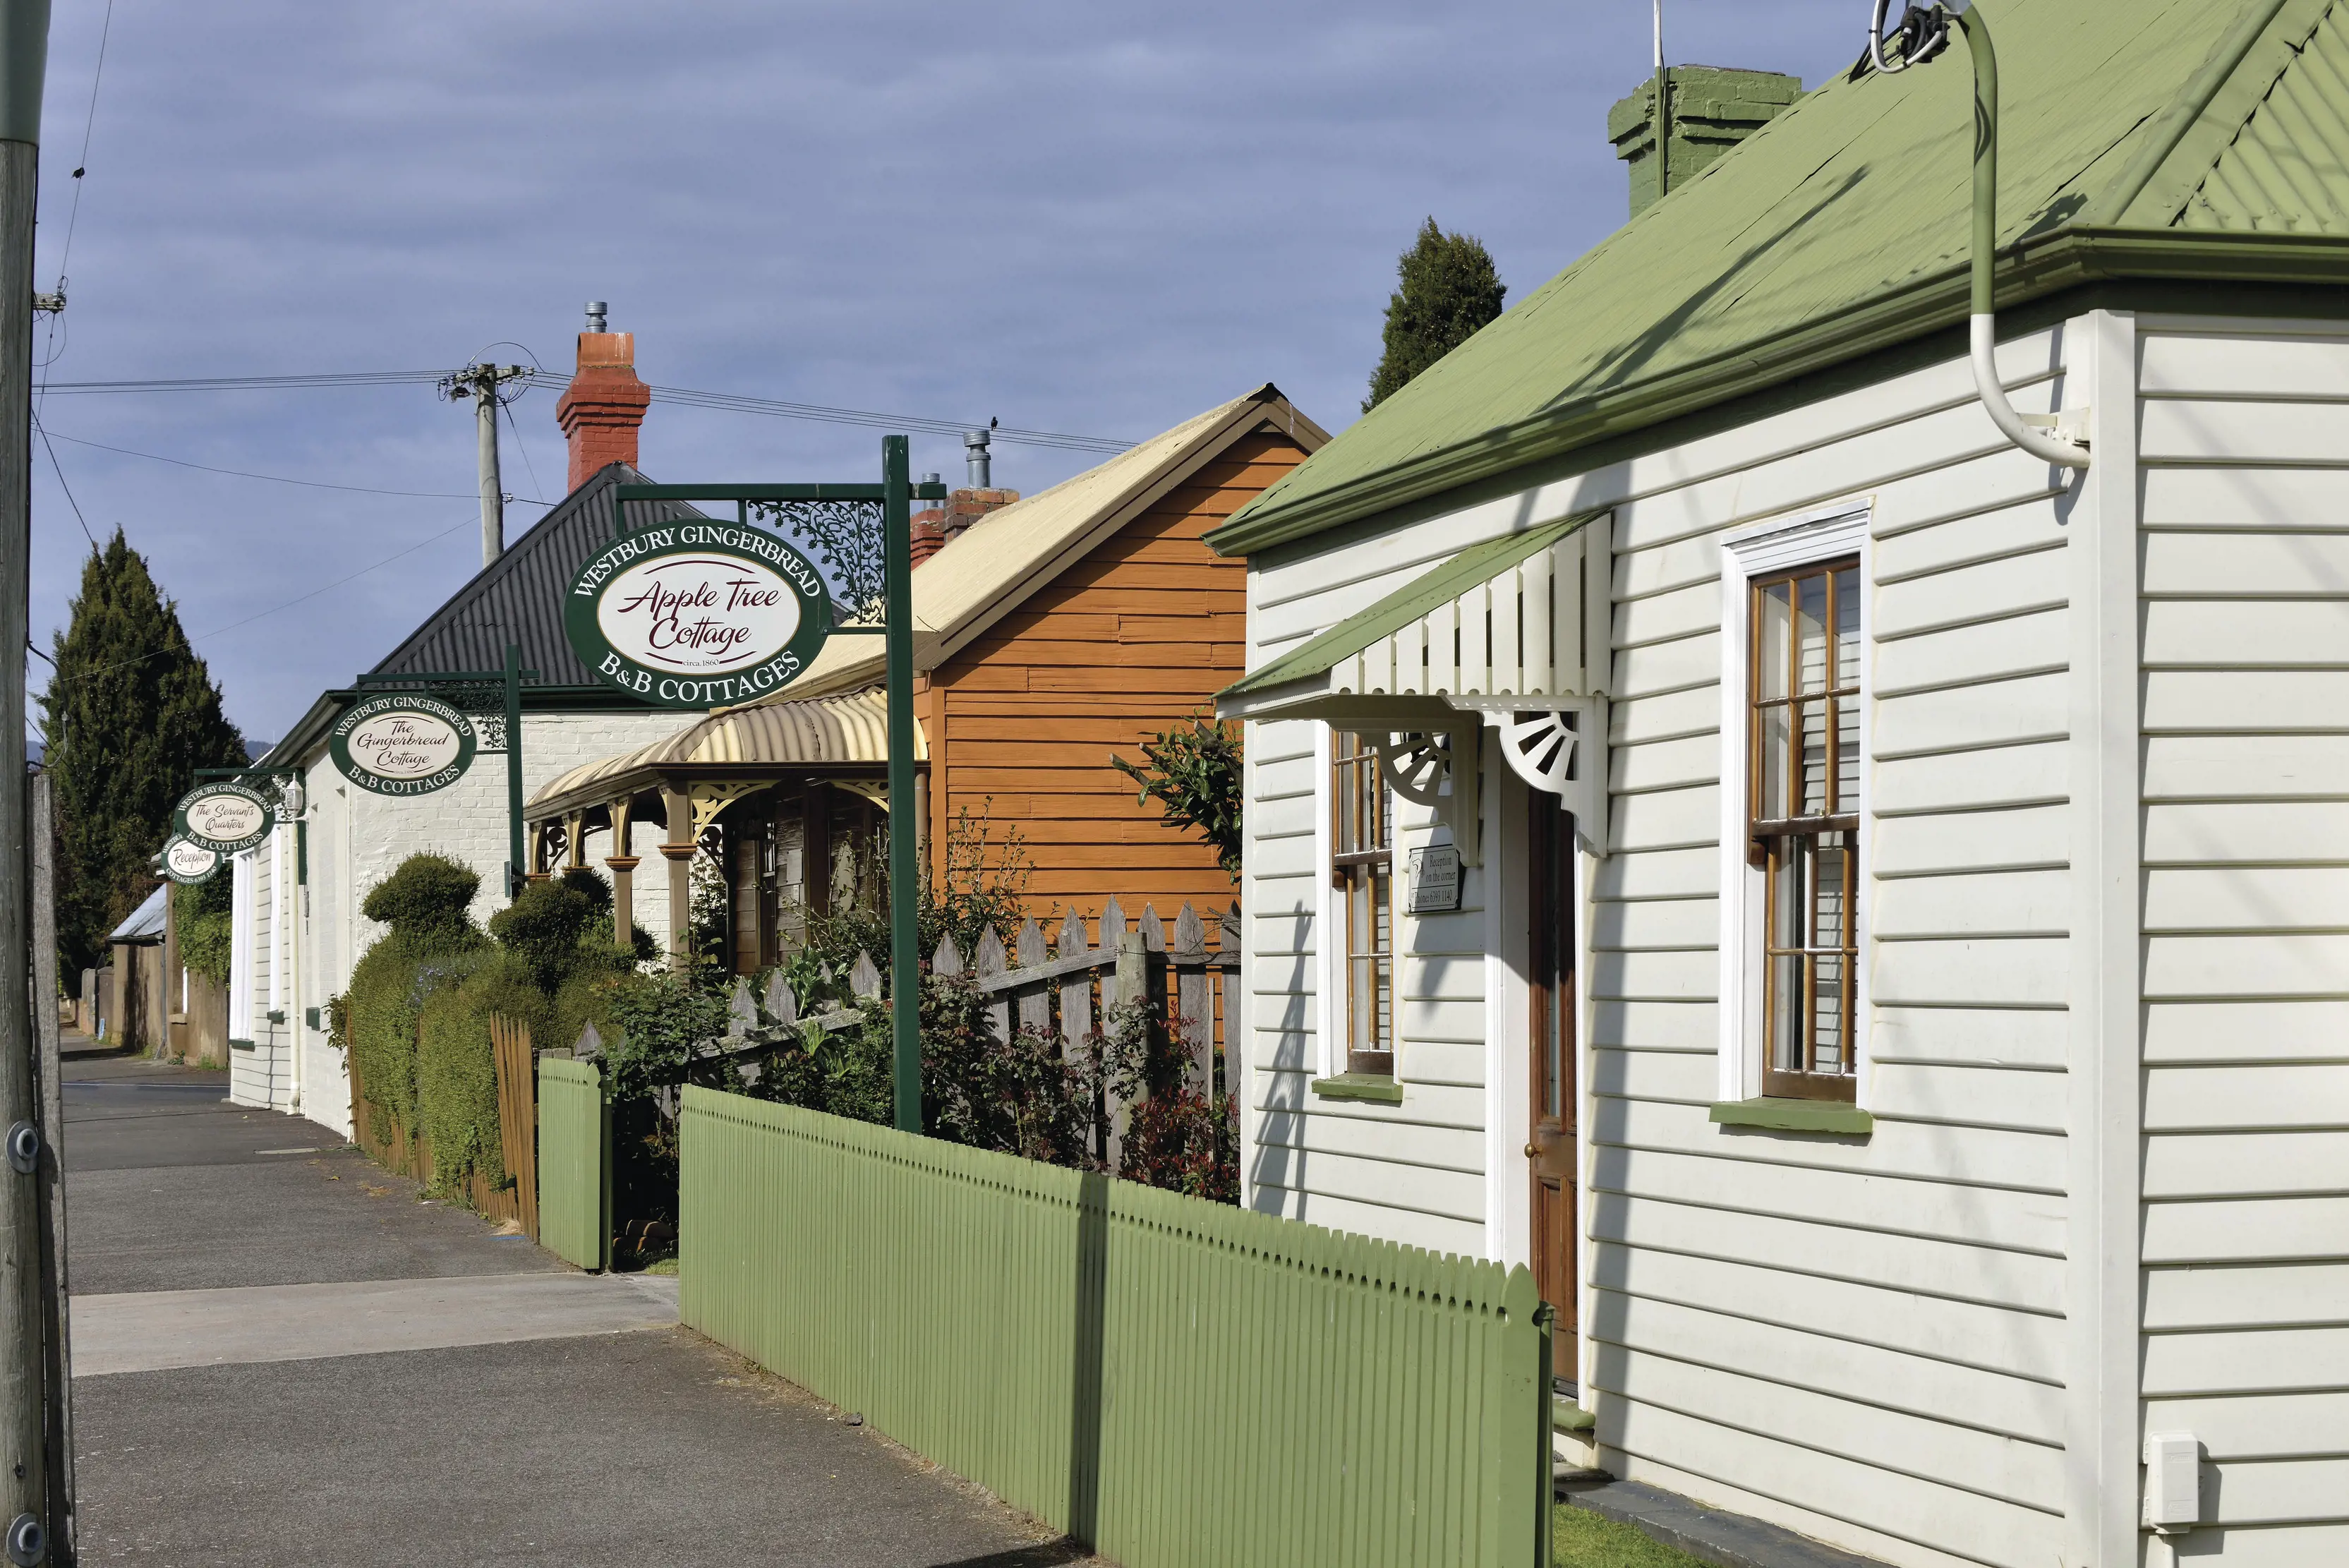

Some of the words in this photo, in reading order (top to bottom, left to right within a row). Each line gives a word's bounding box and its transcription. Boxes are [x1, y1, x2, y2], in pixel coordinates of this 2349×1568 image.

[574, 527, 675, 598] WESTBURY
[681, 526, 821, 598] GINGERBREAD
[617, 581, 720, 621] Apple
[726, 579, 782, 612] Tree
[648, 617, 752, 655] Cottage
[598, 651, 652, 693] B&B
[658, 650, 800, 702] COTTAGES
[335, 698, 392, 736] WESTBURY
[393, 696, 471, 737] GINGERBREAD
[392, 720, 415, 735] The
[357, 732, 450, 751] Gingerbread
[377, 751, 431, 768] Cottage
[348, 765, 378, 788] B&B
[381, 764, 460, 793] COTTAGES
[178, 785, 217, 812] WESTBURY
[218, 785, 272, 813] GINGERBREAD
[196, 804, 211, 817] The
[214, 804, 255, 818] Servant's
[205, 817, 246, 833] Quarters
[186, 831, 207, 848] B&B
[209, 831, 263, 851] COTTAGES
[174, 849, 211, 869] Reception
[1430, 853, 1452, 869] Reception
[166, 868, 194, 883] COTTAGES
[194, 874, 206, 883] 6393
[207, 866, 217, 878] 1140
[1425, 873, 1432, 883] on
[1441, 872, 1456, 881] corner
[1430, 890, 1440, 903] 6393
[1442, 889, 1452, 902] 1140
